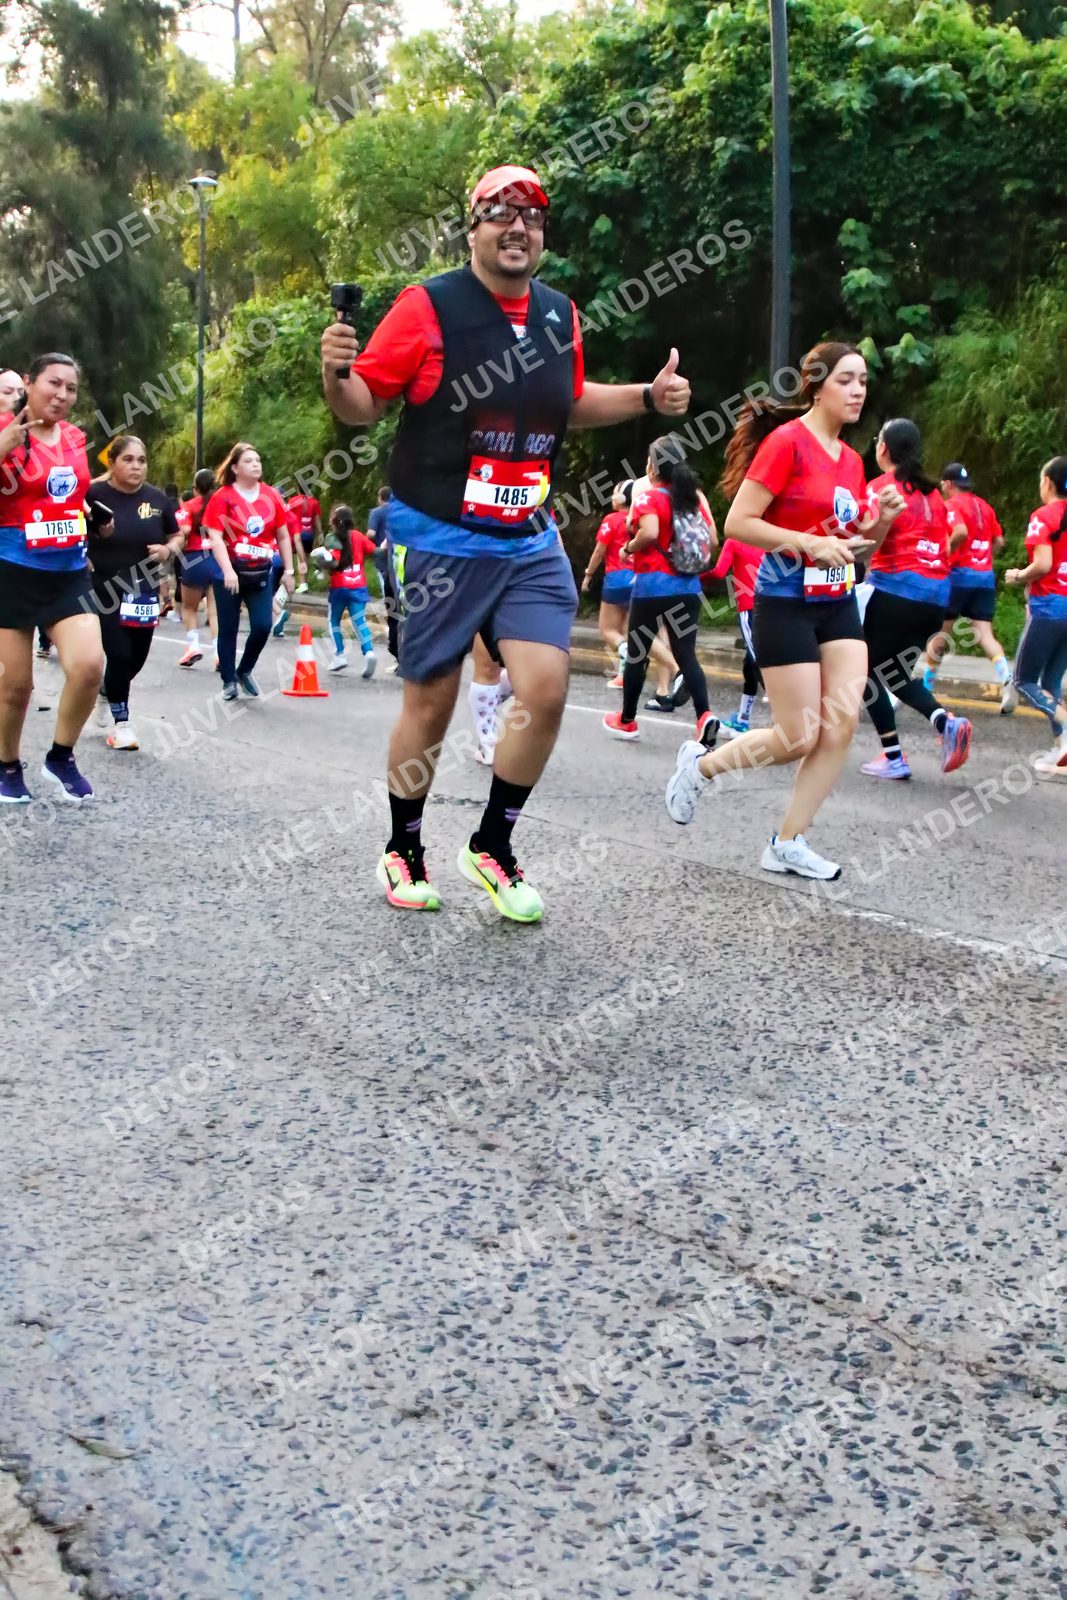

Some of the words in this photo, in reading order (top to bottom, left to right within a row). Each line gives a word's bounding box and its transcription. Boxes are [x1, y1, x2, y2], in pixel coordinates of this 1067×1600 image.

[494, 486, 529, 506] 1485
[45, 521, 75, 536] 17615
[825, 566, 846, 583] 1950
